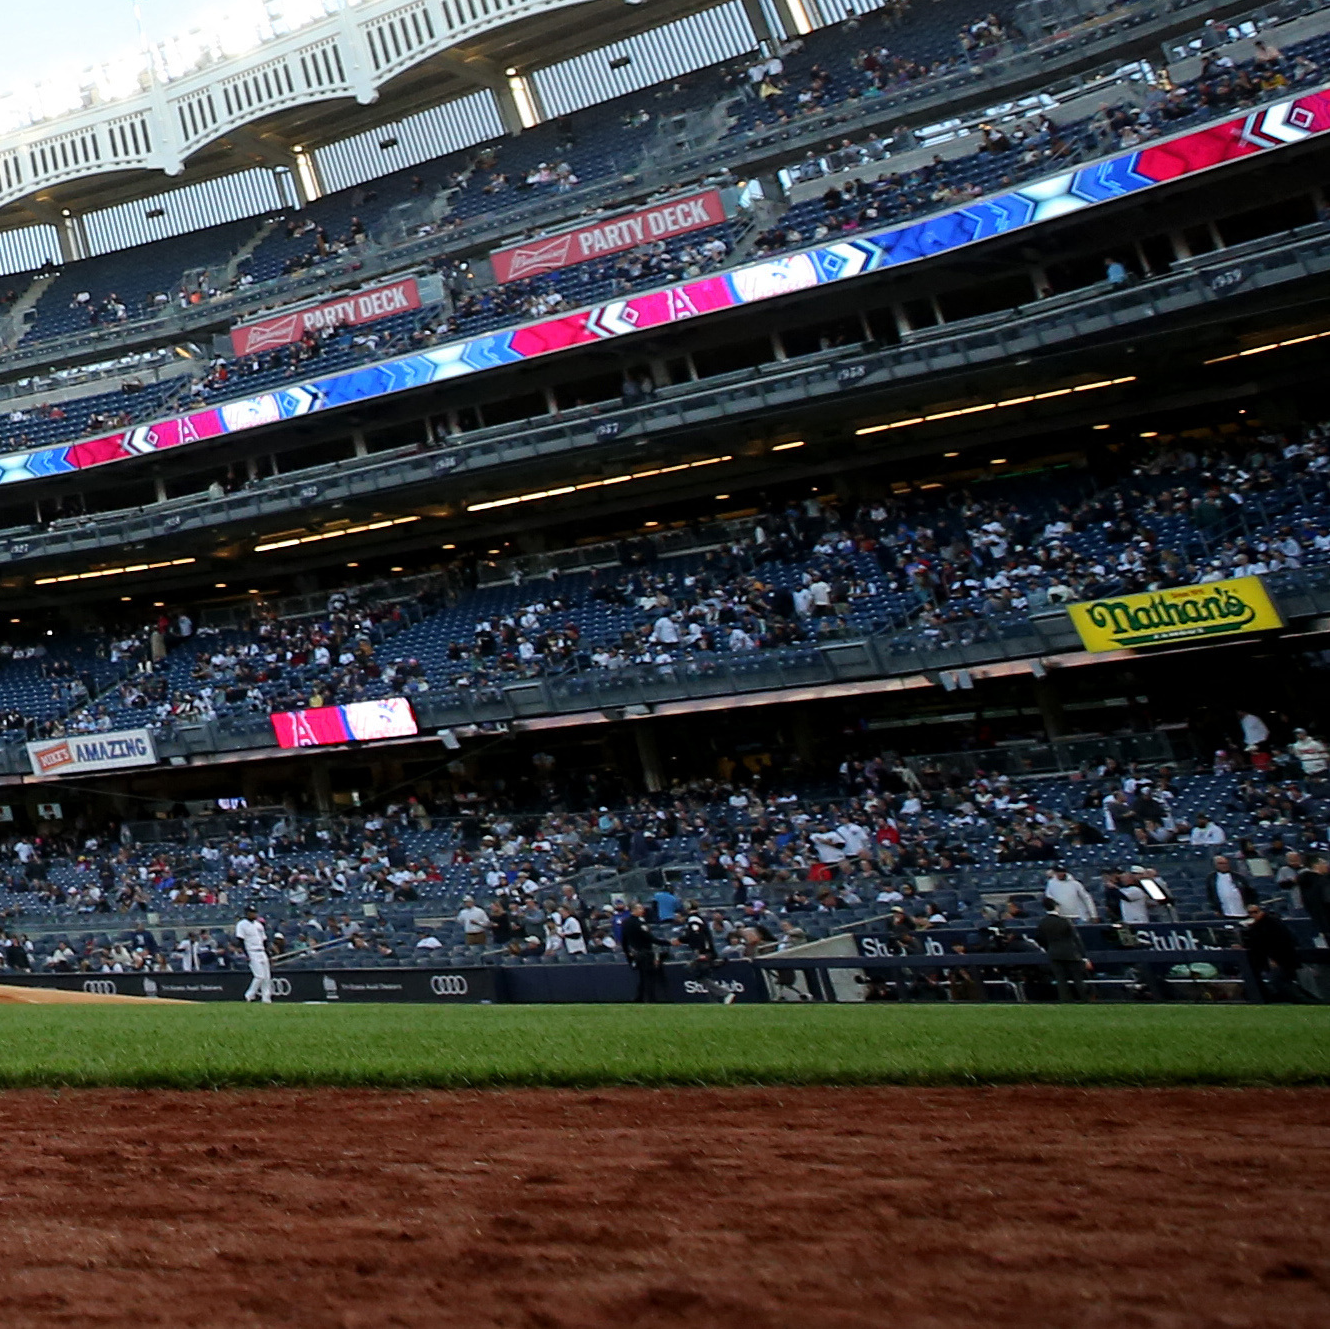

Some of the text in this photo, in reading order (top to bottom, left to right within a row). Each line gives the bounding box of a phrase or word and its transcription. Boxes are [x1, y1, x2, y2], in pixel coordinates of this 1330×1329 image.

[578, 214, 645, 257] PARTY
[647, 198, 711, 237] DECK
[302, 299, 357, 332] PARTY
[359, 286, 410, 319] DECK
[1086, 586, 1246, 635] Nathan's
[75, 737, 147, 763] AMAZING
